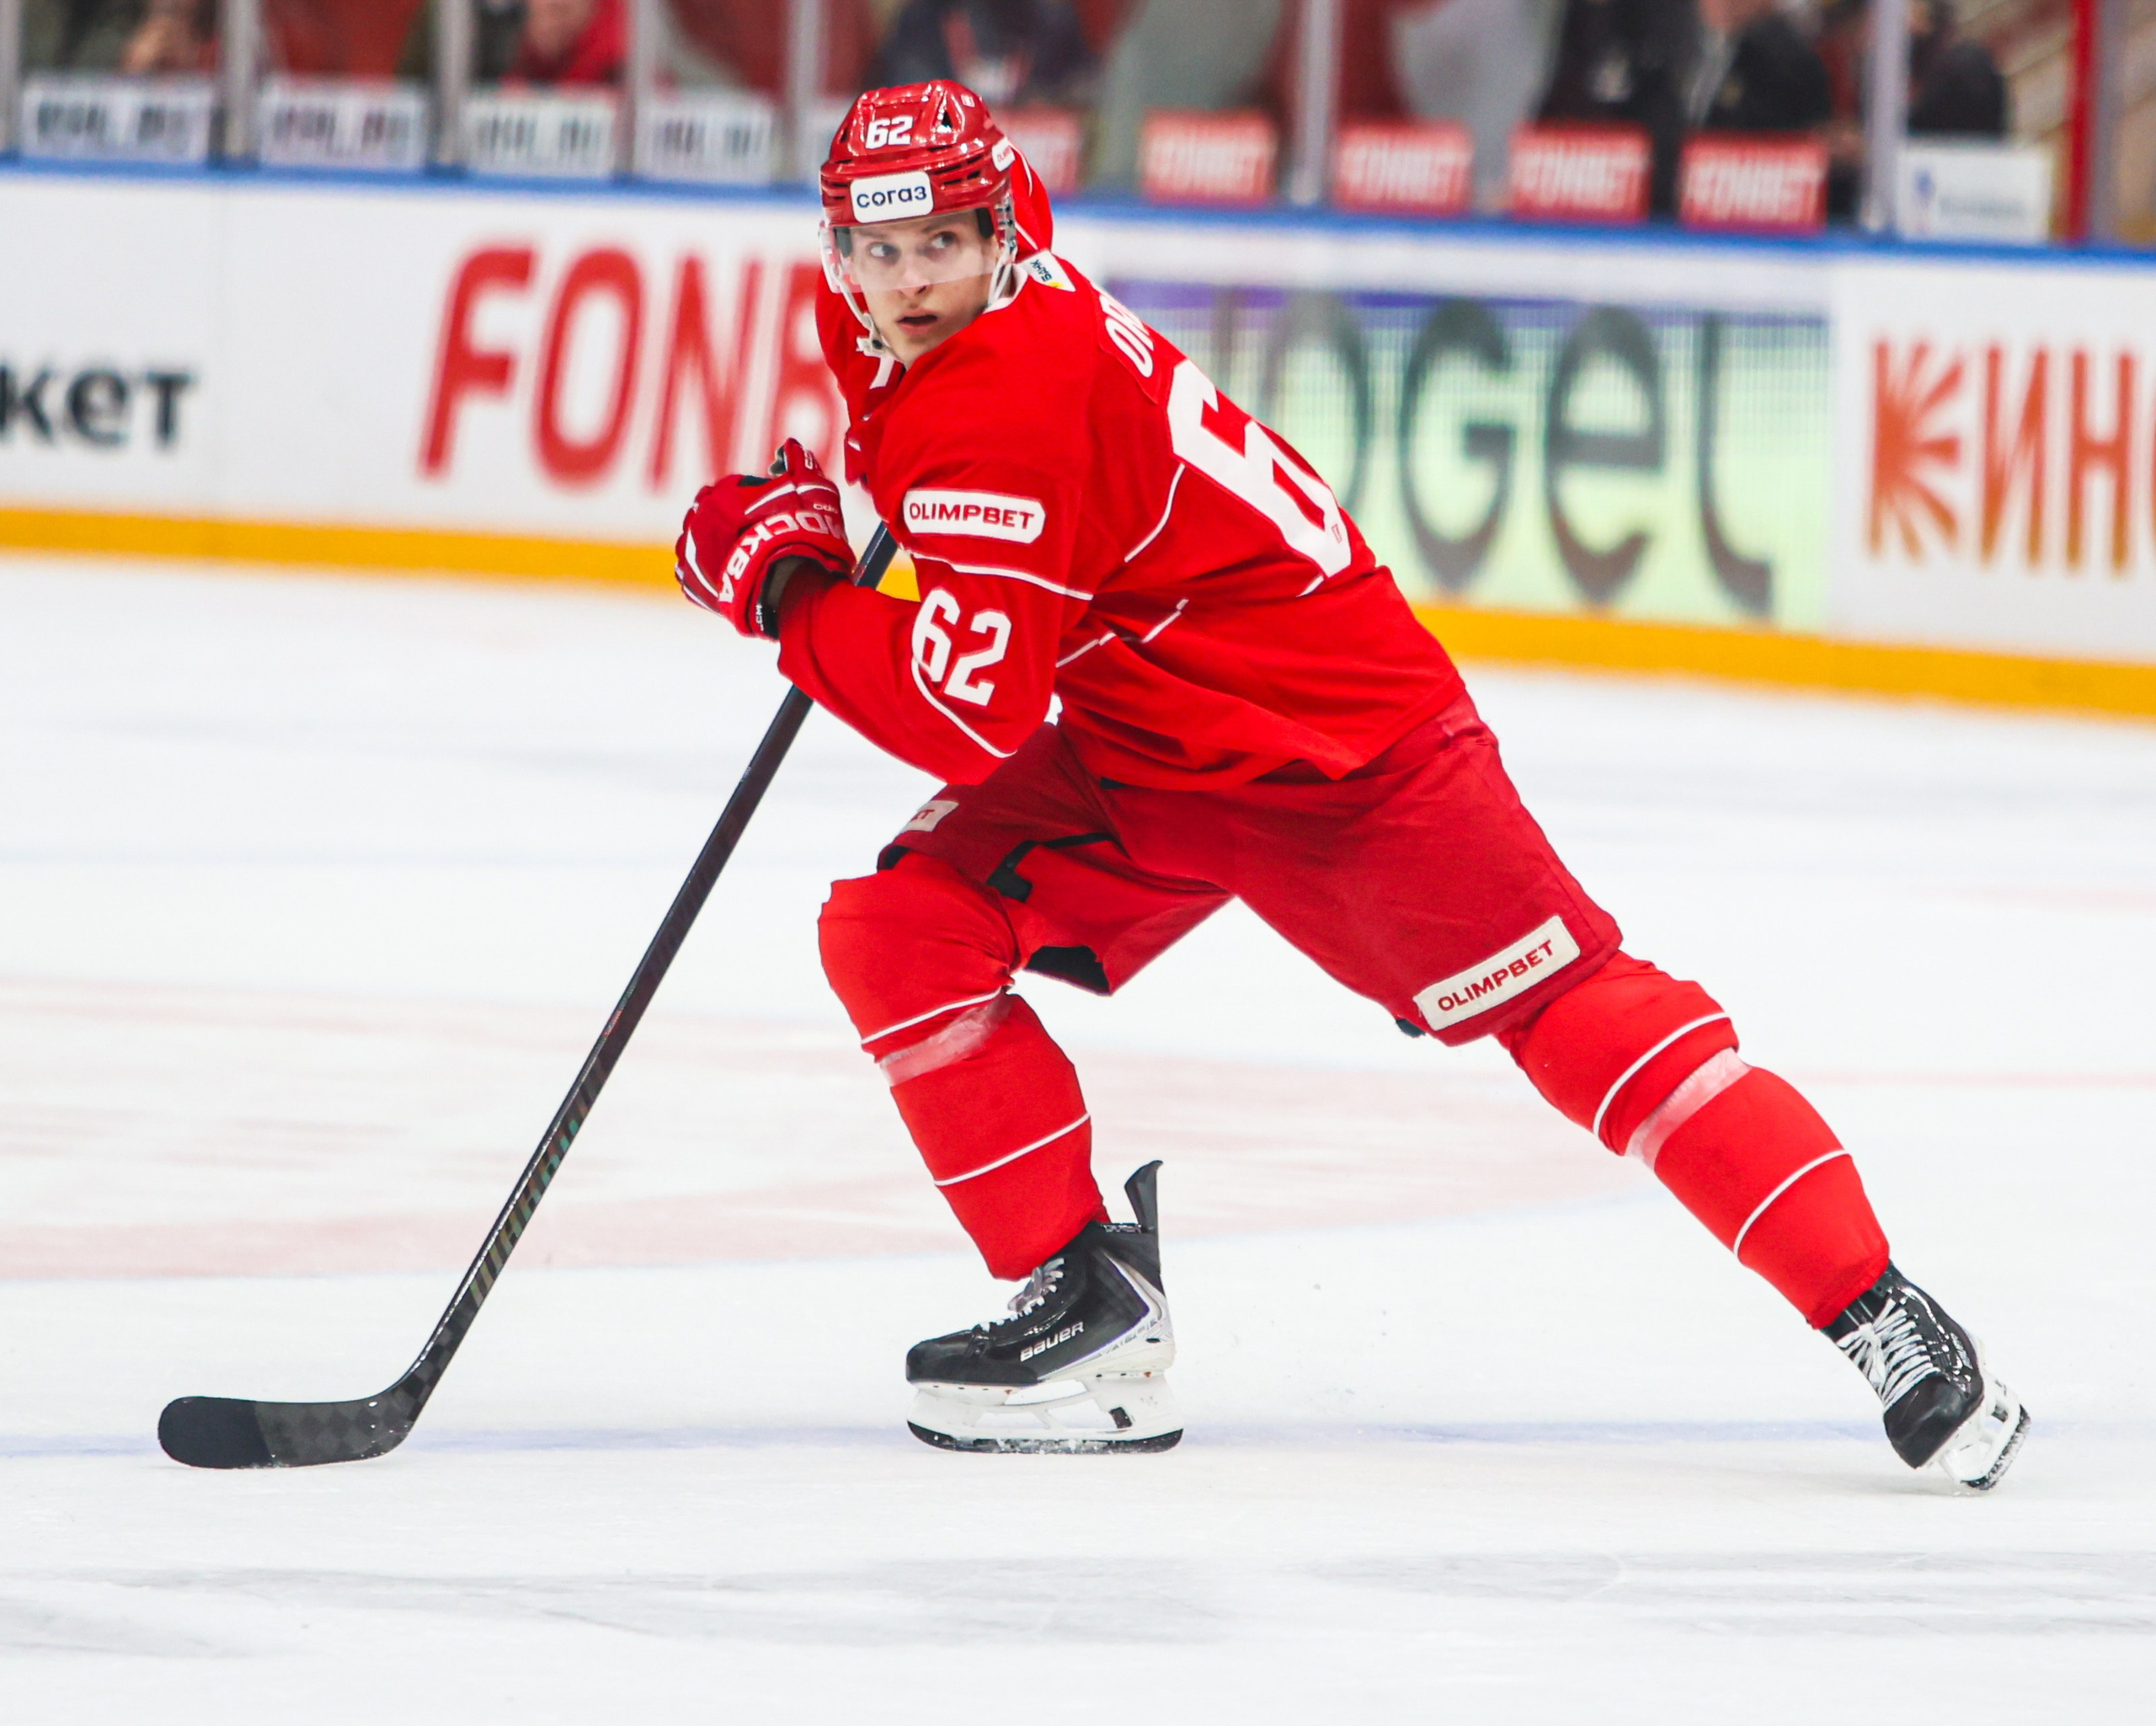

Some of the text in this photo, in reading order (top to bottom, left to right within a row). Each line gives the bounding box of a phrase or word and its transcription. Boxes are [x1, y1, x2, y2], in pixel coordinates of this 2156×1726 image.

[866, 115, 914, 149] 62
[857, 185, 927, 208] согаз
[1868, 337, 2156, 574] КИН
[909, 502, 1036, 531] OLIMPBET
[911, 585, 1012, 708] 62
[1437, 938, 1555, 1013] OLIMPBET
